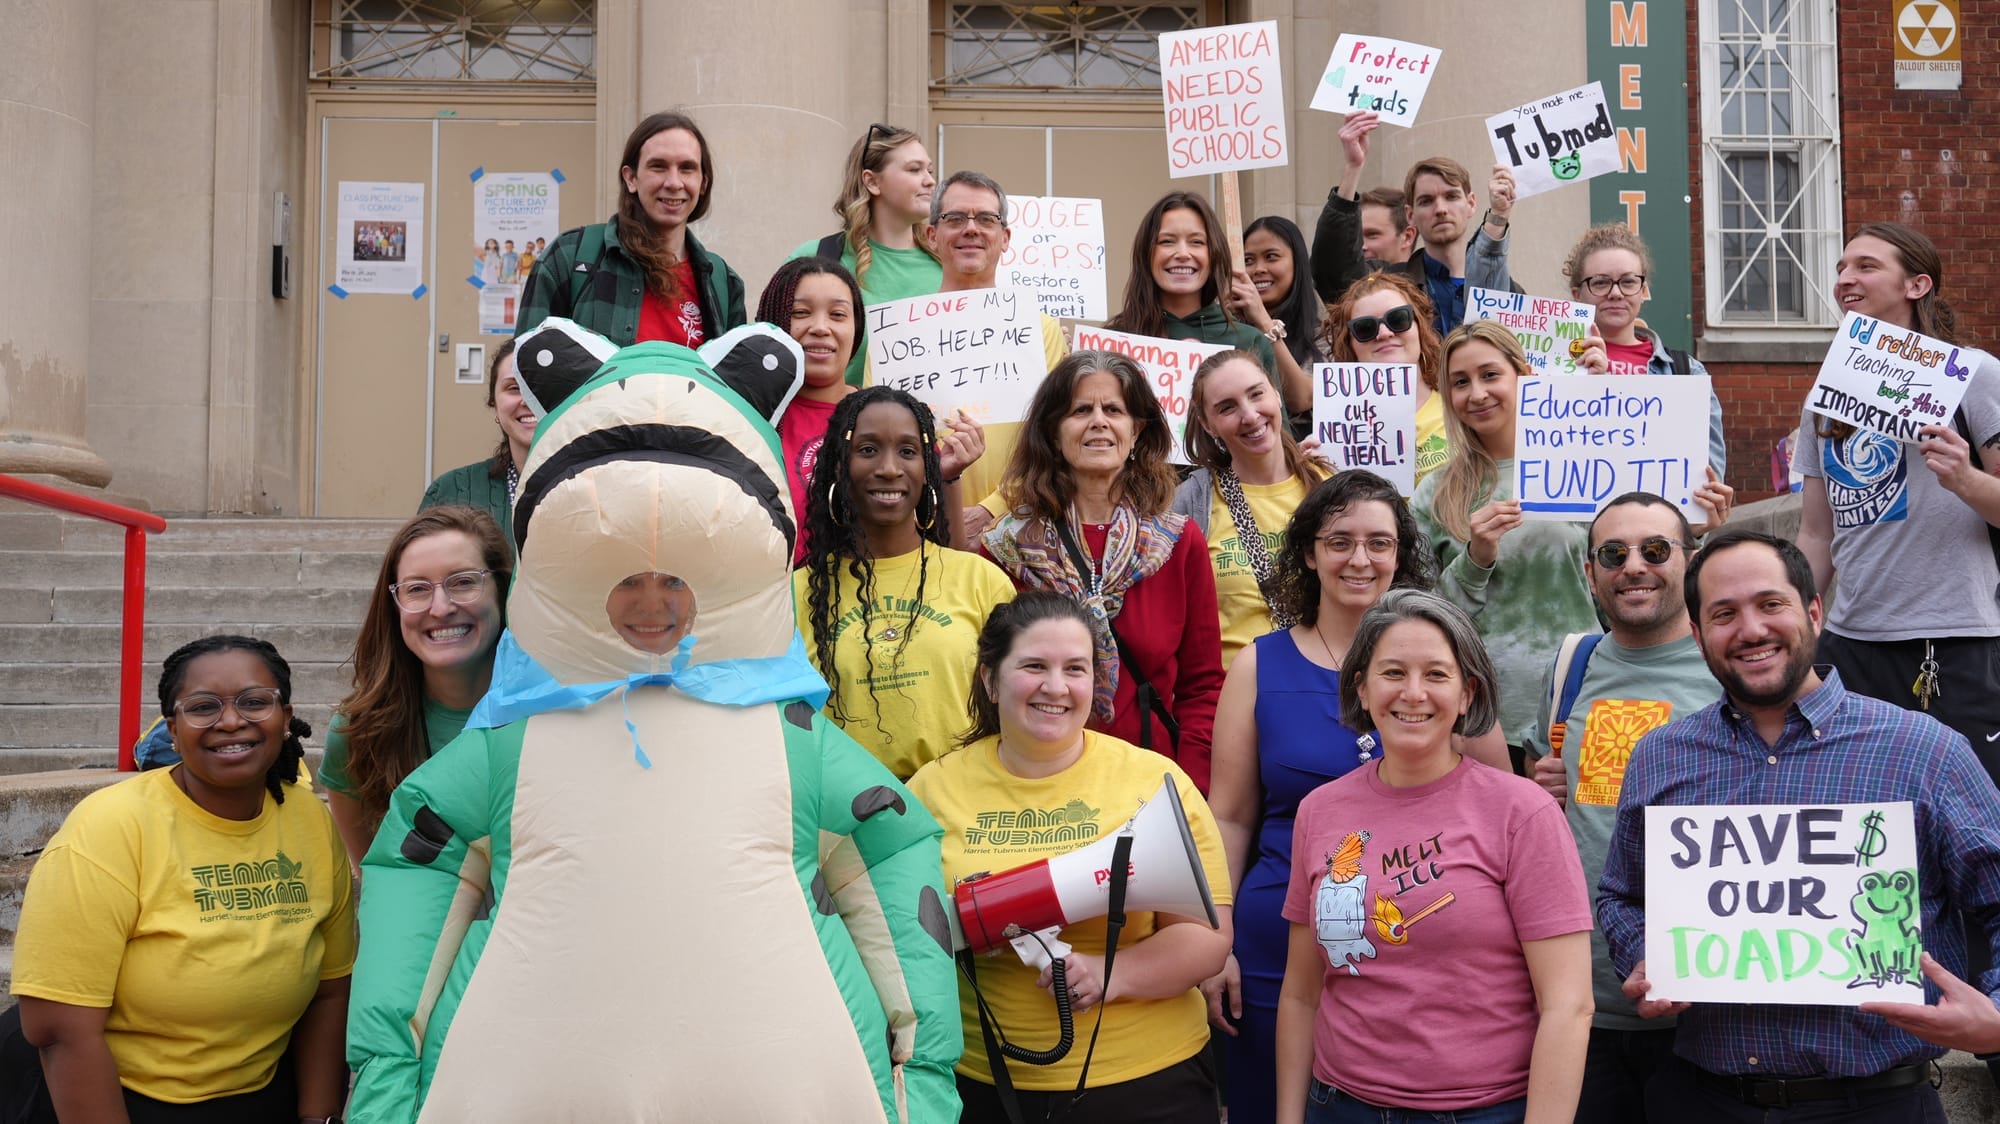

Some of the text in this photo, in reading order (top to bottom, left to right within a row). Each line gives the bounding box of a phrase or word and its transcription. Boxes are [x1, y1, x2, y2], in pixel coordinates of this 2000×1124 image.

[1169, 28, 1271, 67] AMERICA
[1349, 41, 1430, 74] Protect
[1366, 74, 1393, 85] our
[1895, 61, 1961, 72] FALLOUT SHELTER
[1167, 66, 1263, 104] NEEDS
[1169, 102, 1261, 133] PUBLIC
[1513, 106, 1537, 119] You
[1542, 96, 1564, 110] made
[1172, 125, 1282, 169] SCHOOLS
[1494, 103, 1613, 167] Tubmad
[484, 183, 549, 198] SPRING
[484, 198, 549, 207] PICTURE DAY
[488, 207, 545, 216] IS COMING!
[1032, 233, 1057, 244] or
[1011, 270, 1080, 289] Restore
[868, 306, 899, 333] I
[908, 296, 969, 323] LOVE
[1040, 305, 1085, 318] dget!
[1473, 288, 1589, 319] You'll NEVER see
[1480, 310, 1586, 340] a TEACHER WIN
[878, 326, 1033, 365] JOB. HELP ME
[1079, 331, 1179, 368] mañana
[1517, 332, 1554, 353] OTTO
[1849, 316, 1970, 382] I'd rather be
[1526, 352, 1548, 369] that
[1845, 346, 1932, 392] Teaching
[881, 372, 941, 392] KEEP
[1322, 366, 1413, 398] BUDGET
[1344, 399, 1377, 421] cuts
[1520, 381, 1663, 420] Education
[1814, 384, 1943, 442] IMPORTANT
[1877, 380, 1947, 418] but this
[1899, 405, 1912, 418] is
[1319, 421, 1388, 445] NEVER
[1343, 430, 1405, 466] HEAL!
[1525, 421, 1647, 447] matters!
[802, 446, 817, 468] UNITY
[1520, 457, 1689, 506] FUND IT!
[1828, 482, 1878, 506] HARDY
[1837, 482, 1899, 527] UNITED
[828, 600, 881, 642] Harrit
[1576, 793, 1606, 805] COFFEE
[965, 822, 1099, 846] TUBMAN
[976, 808, 1067, 830] TEAM
[1028, 844, 1074, 853] Elementary
[1075, 840, 1096, 850] Scho
[1382, 832, 1443, 875] MELT
[1670, 809, 1855, 869] SAVE
[191, 859, 280, 888] TEAM
[1390, 861, 1445, 897] ICE
[194, 881, 308, 912] TUBMAN
[1708, 876, 1838, 920] OUR
[200, 913, 231, 923] Harriet
[256, 908, 291, 921] Elementary
[1666, 926, 1859, 983] TOADS
